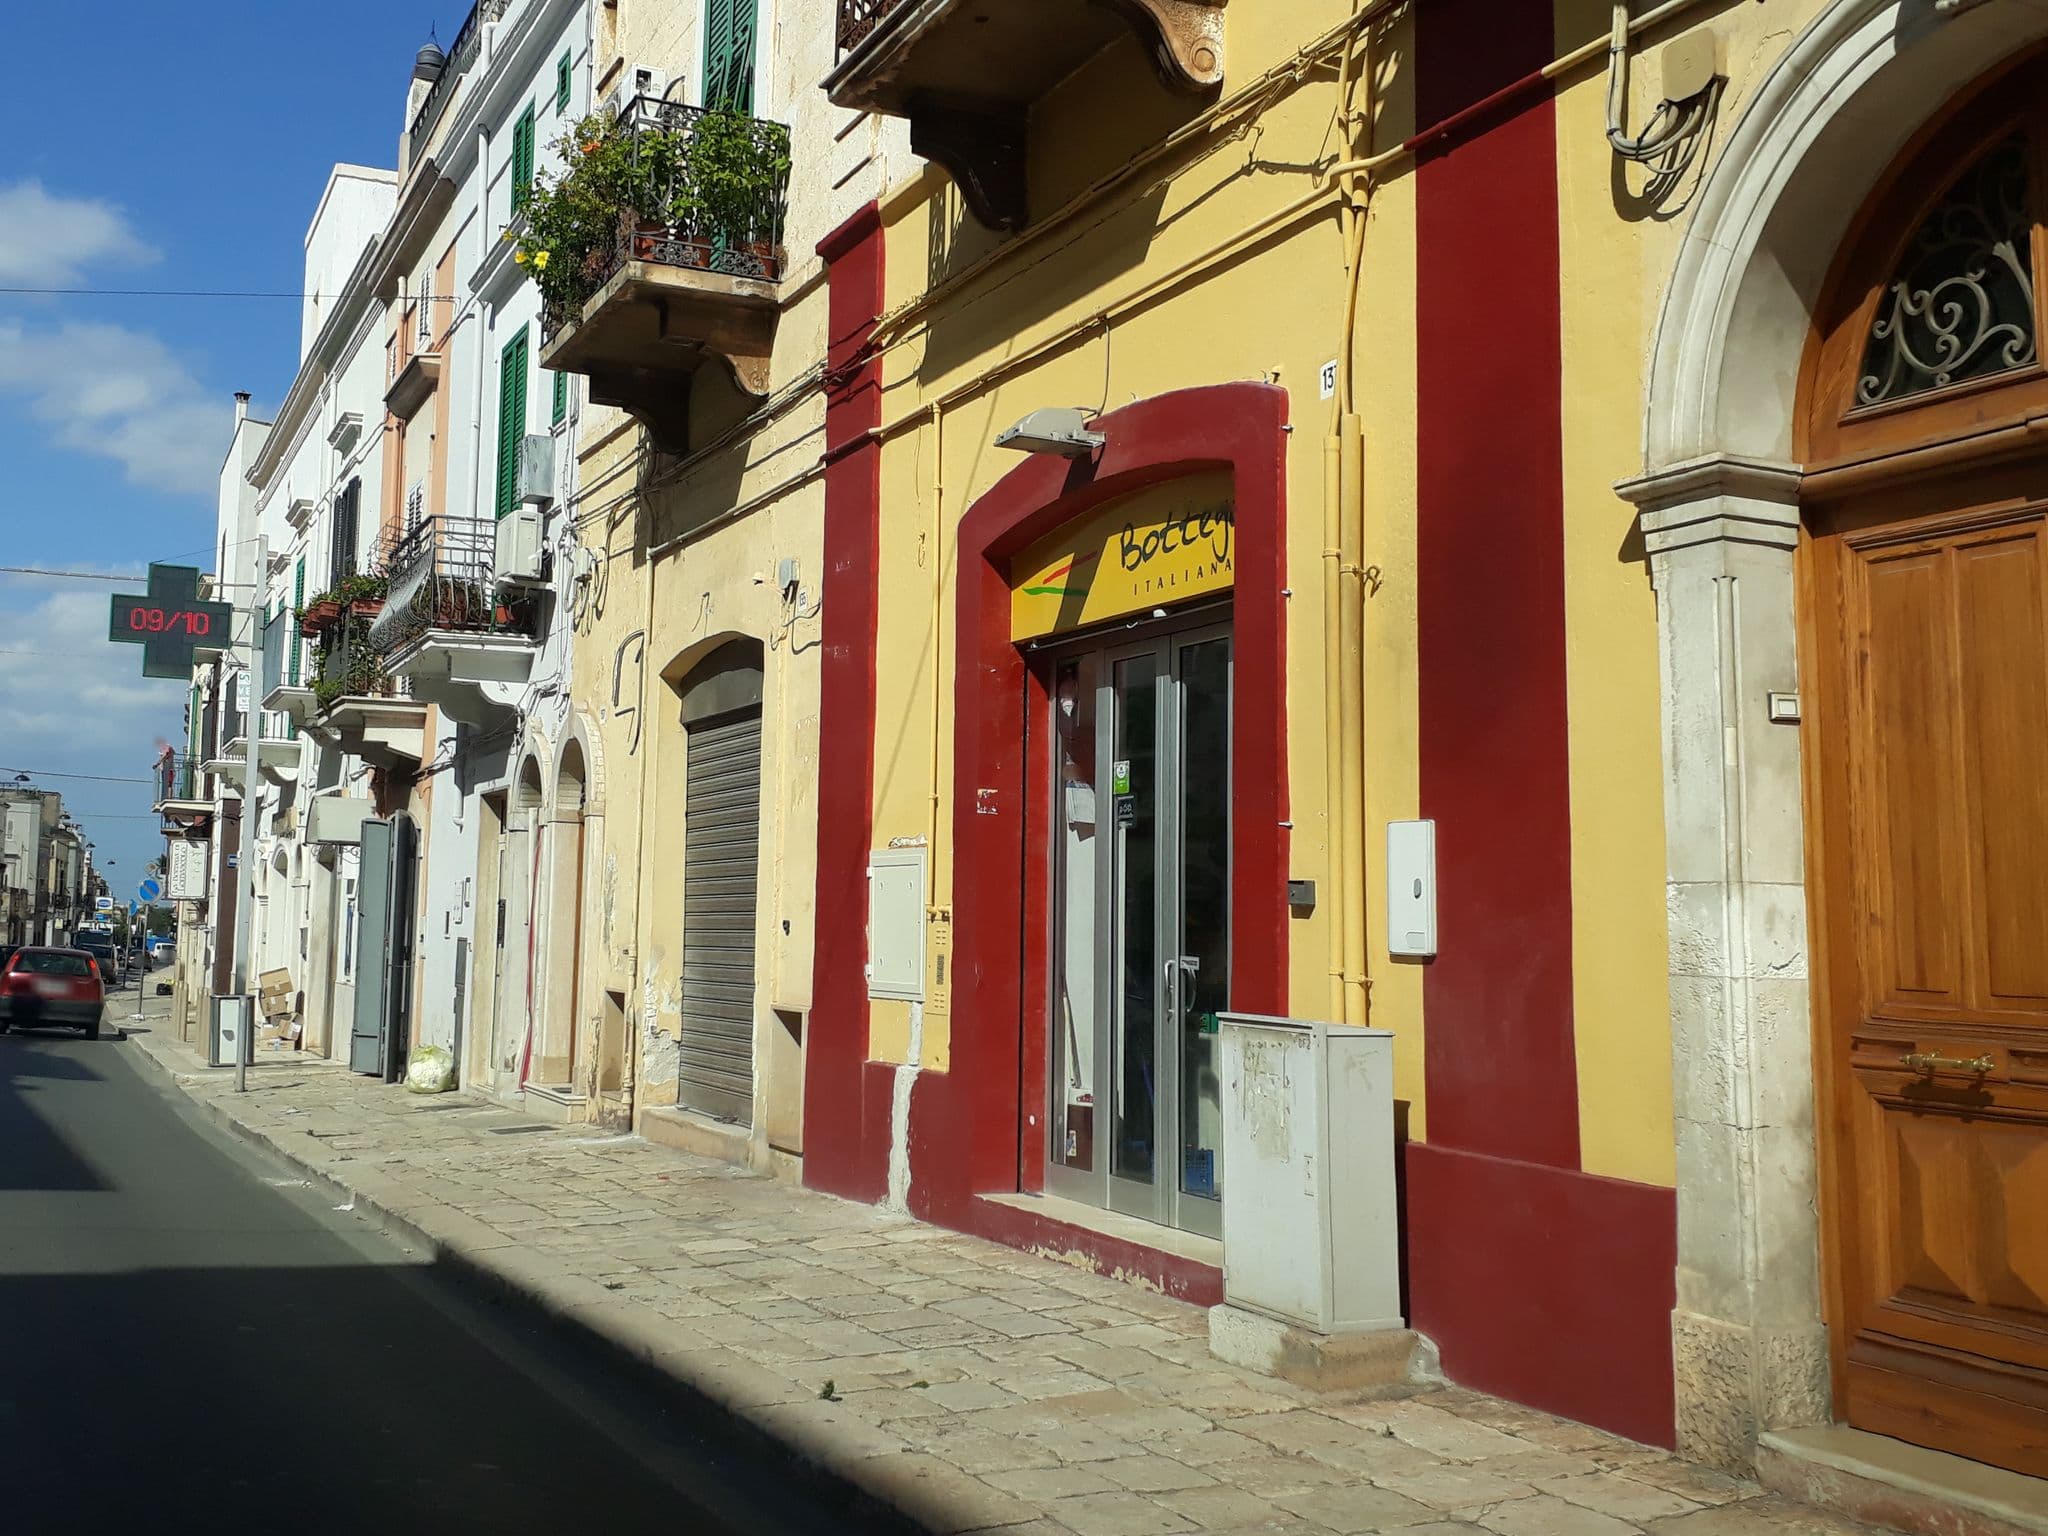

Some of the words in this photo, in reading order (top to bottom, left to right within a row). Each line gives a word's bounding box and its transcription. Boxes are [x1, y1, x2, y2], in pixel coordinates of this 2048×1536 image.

[1120, 508, 1235, 573] Botteg
[1133, 557, 1233, 596] ITALIANA
[129, 607, 210, 636] 09/10
